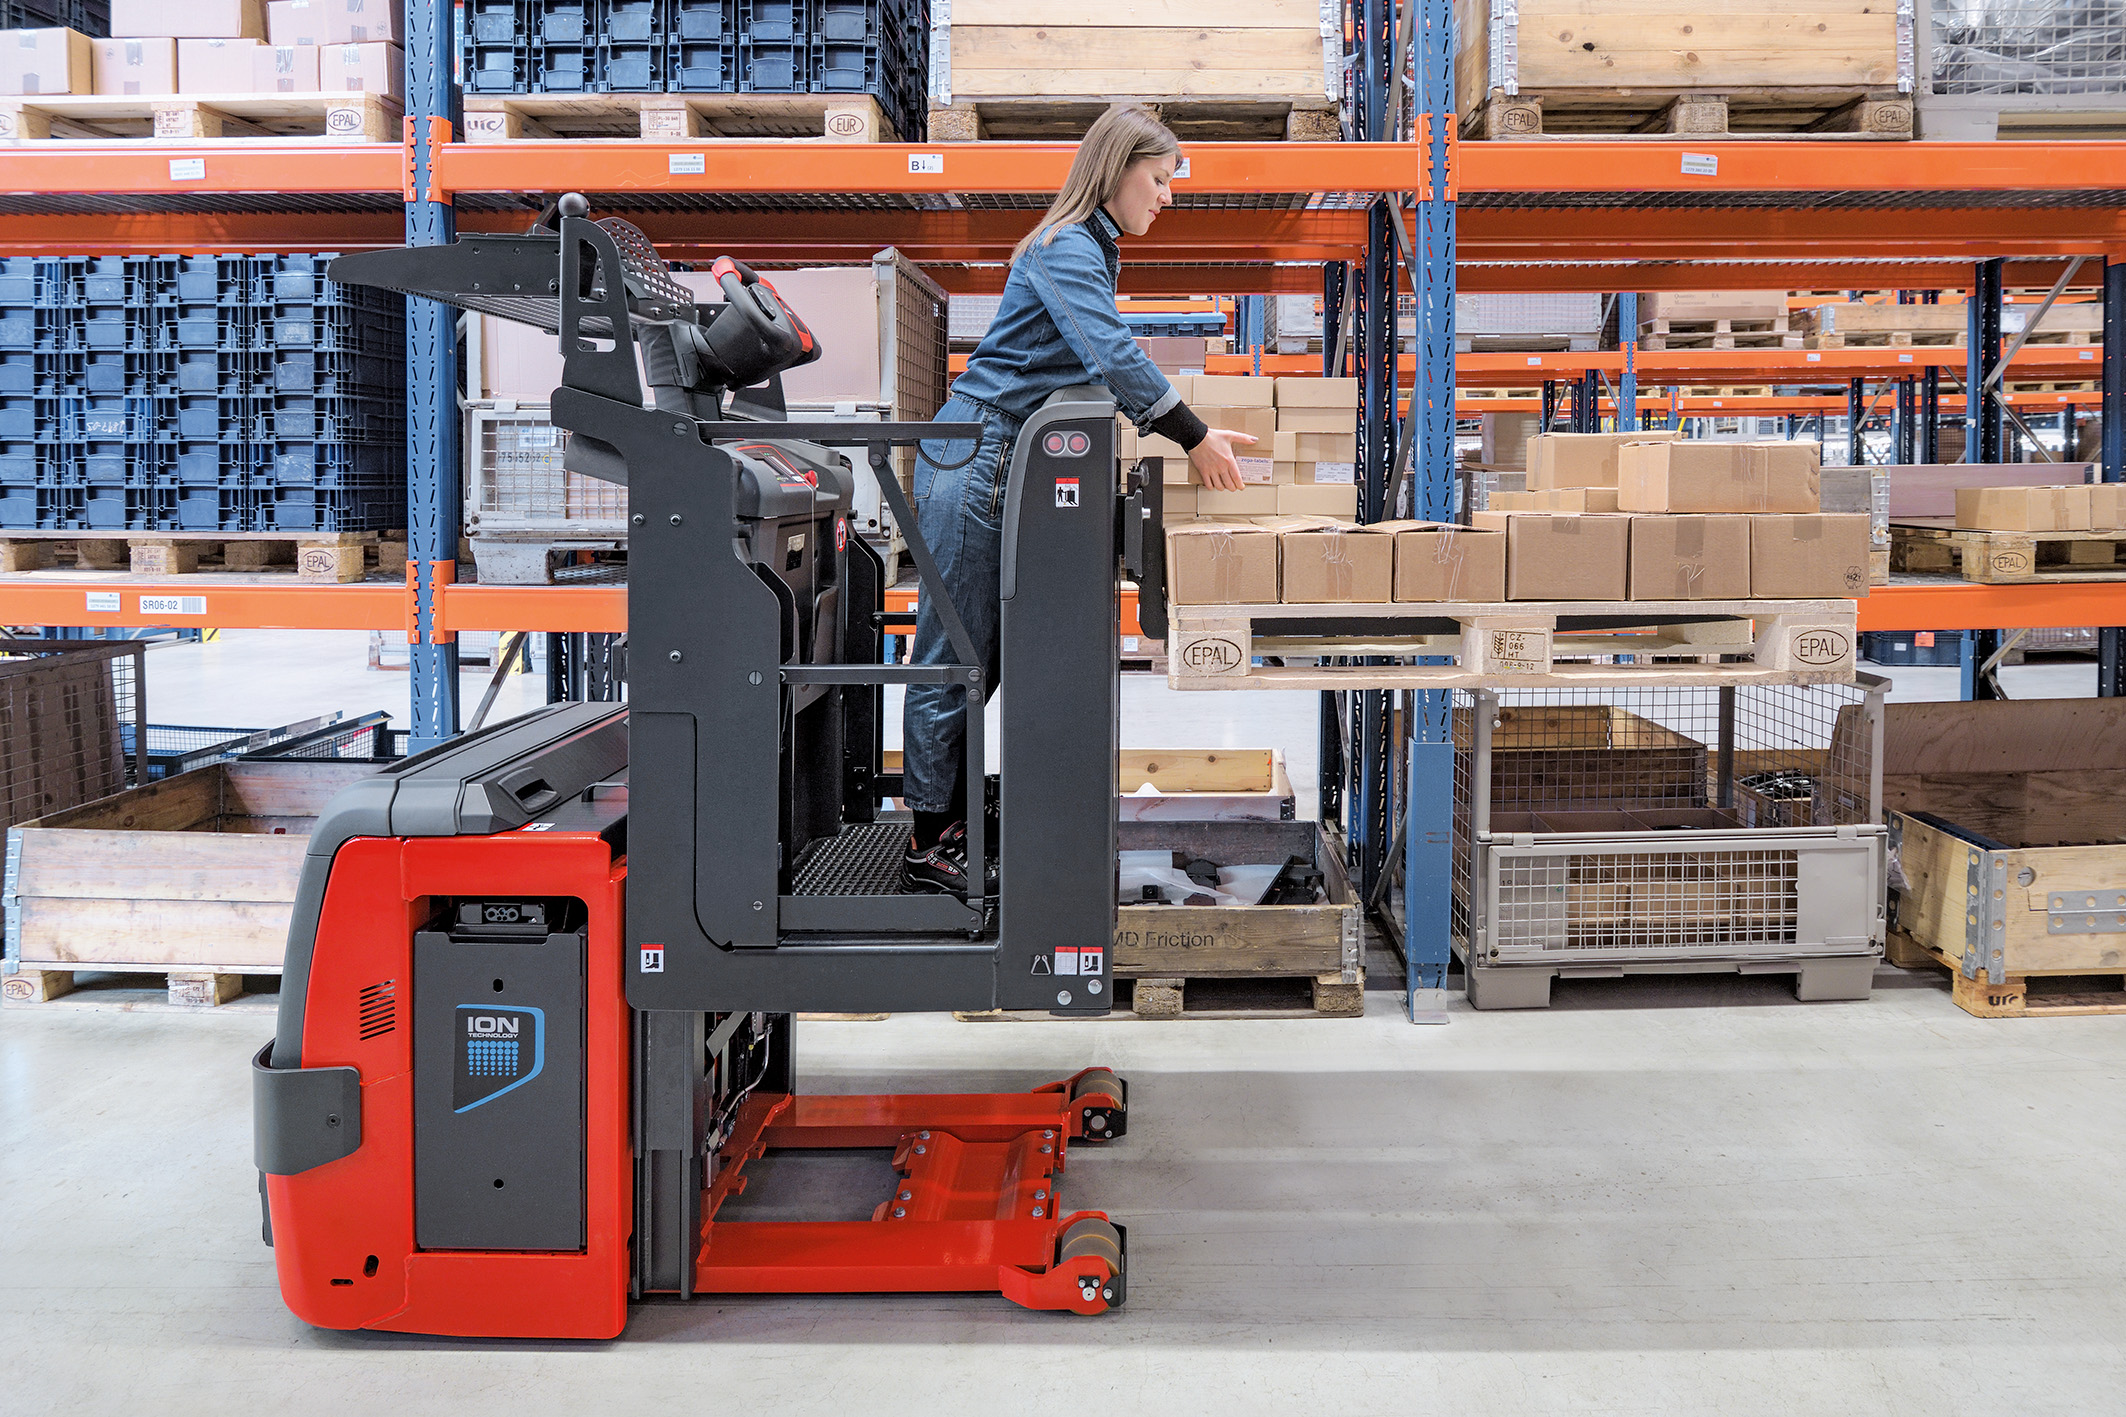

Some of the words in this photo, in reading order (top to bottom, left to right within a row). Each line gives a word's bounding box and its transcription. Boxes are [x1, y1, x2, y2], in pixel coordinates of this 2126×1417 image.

[333, 114, 357, 126] EPAL
[1507, 113, 1533, 126] EPAL
[1879, 110, 1904, 122] EPAL
[836, 118, 856, 132] EUR
[911, 160, 920, 171] B
[307, 555, 330, 568] EPAL
[1998, 557, 2021, 569] EPAL
[143, 600, 178, 610] SR06-02
[1508, 642, 1525, 651] 066
[1800, 638, 1840, 657] EPAL
[1192, 646, 1234, 666] EPAL
[1508, 651, 1520, 659] HT
[1145, 931, 1214, 948] Friction
[6, 985, 29, 996] EPAL
[467, 1016, 519, 1033] ION
